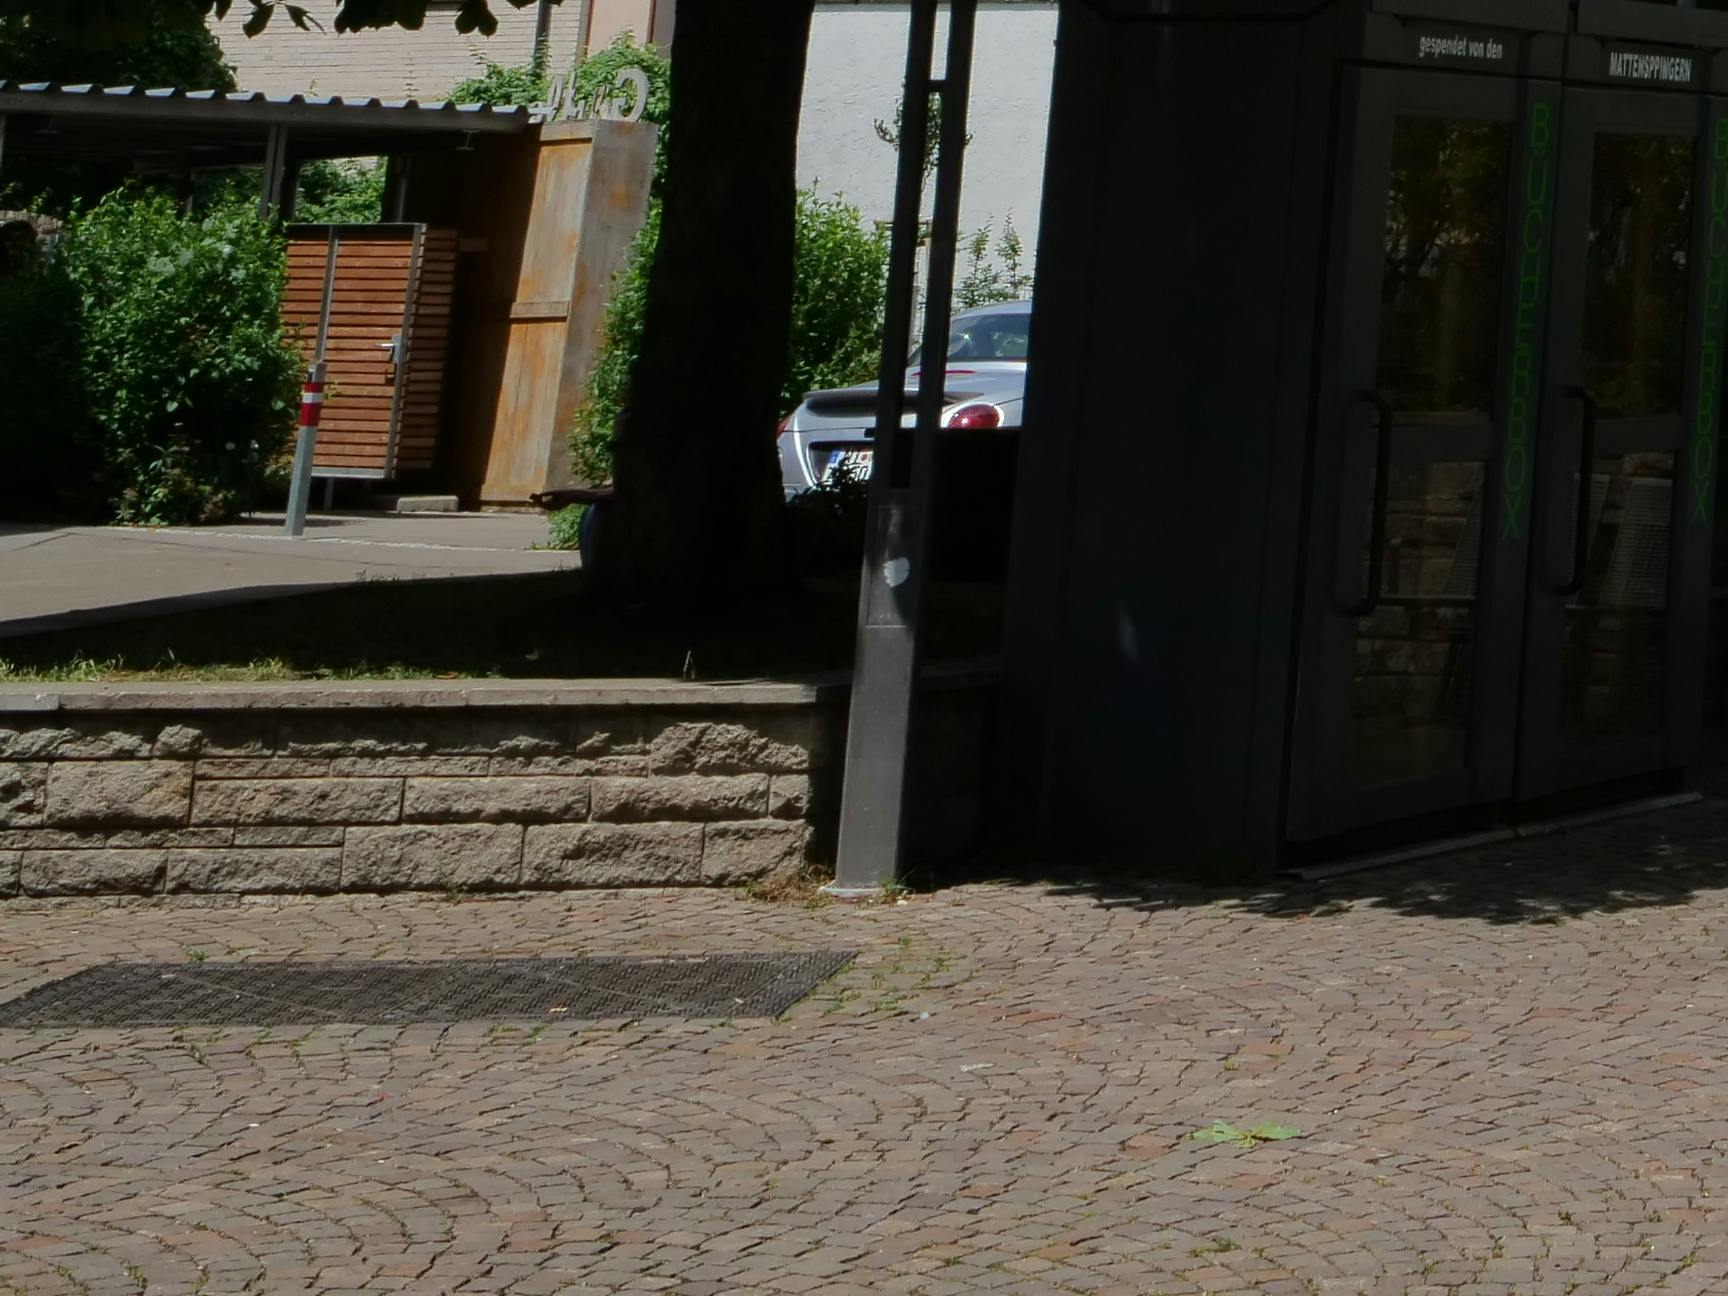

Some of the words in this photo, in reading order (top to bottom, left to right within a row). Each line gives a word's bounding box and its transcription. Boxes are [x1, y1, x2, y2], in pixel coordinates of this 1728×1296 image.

[1418, 34, 1467, 58] gespendet
[1469, 41, 1484, 58] von
[1486, 38, 1503, 59] den
